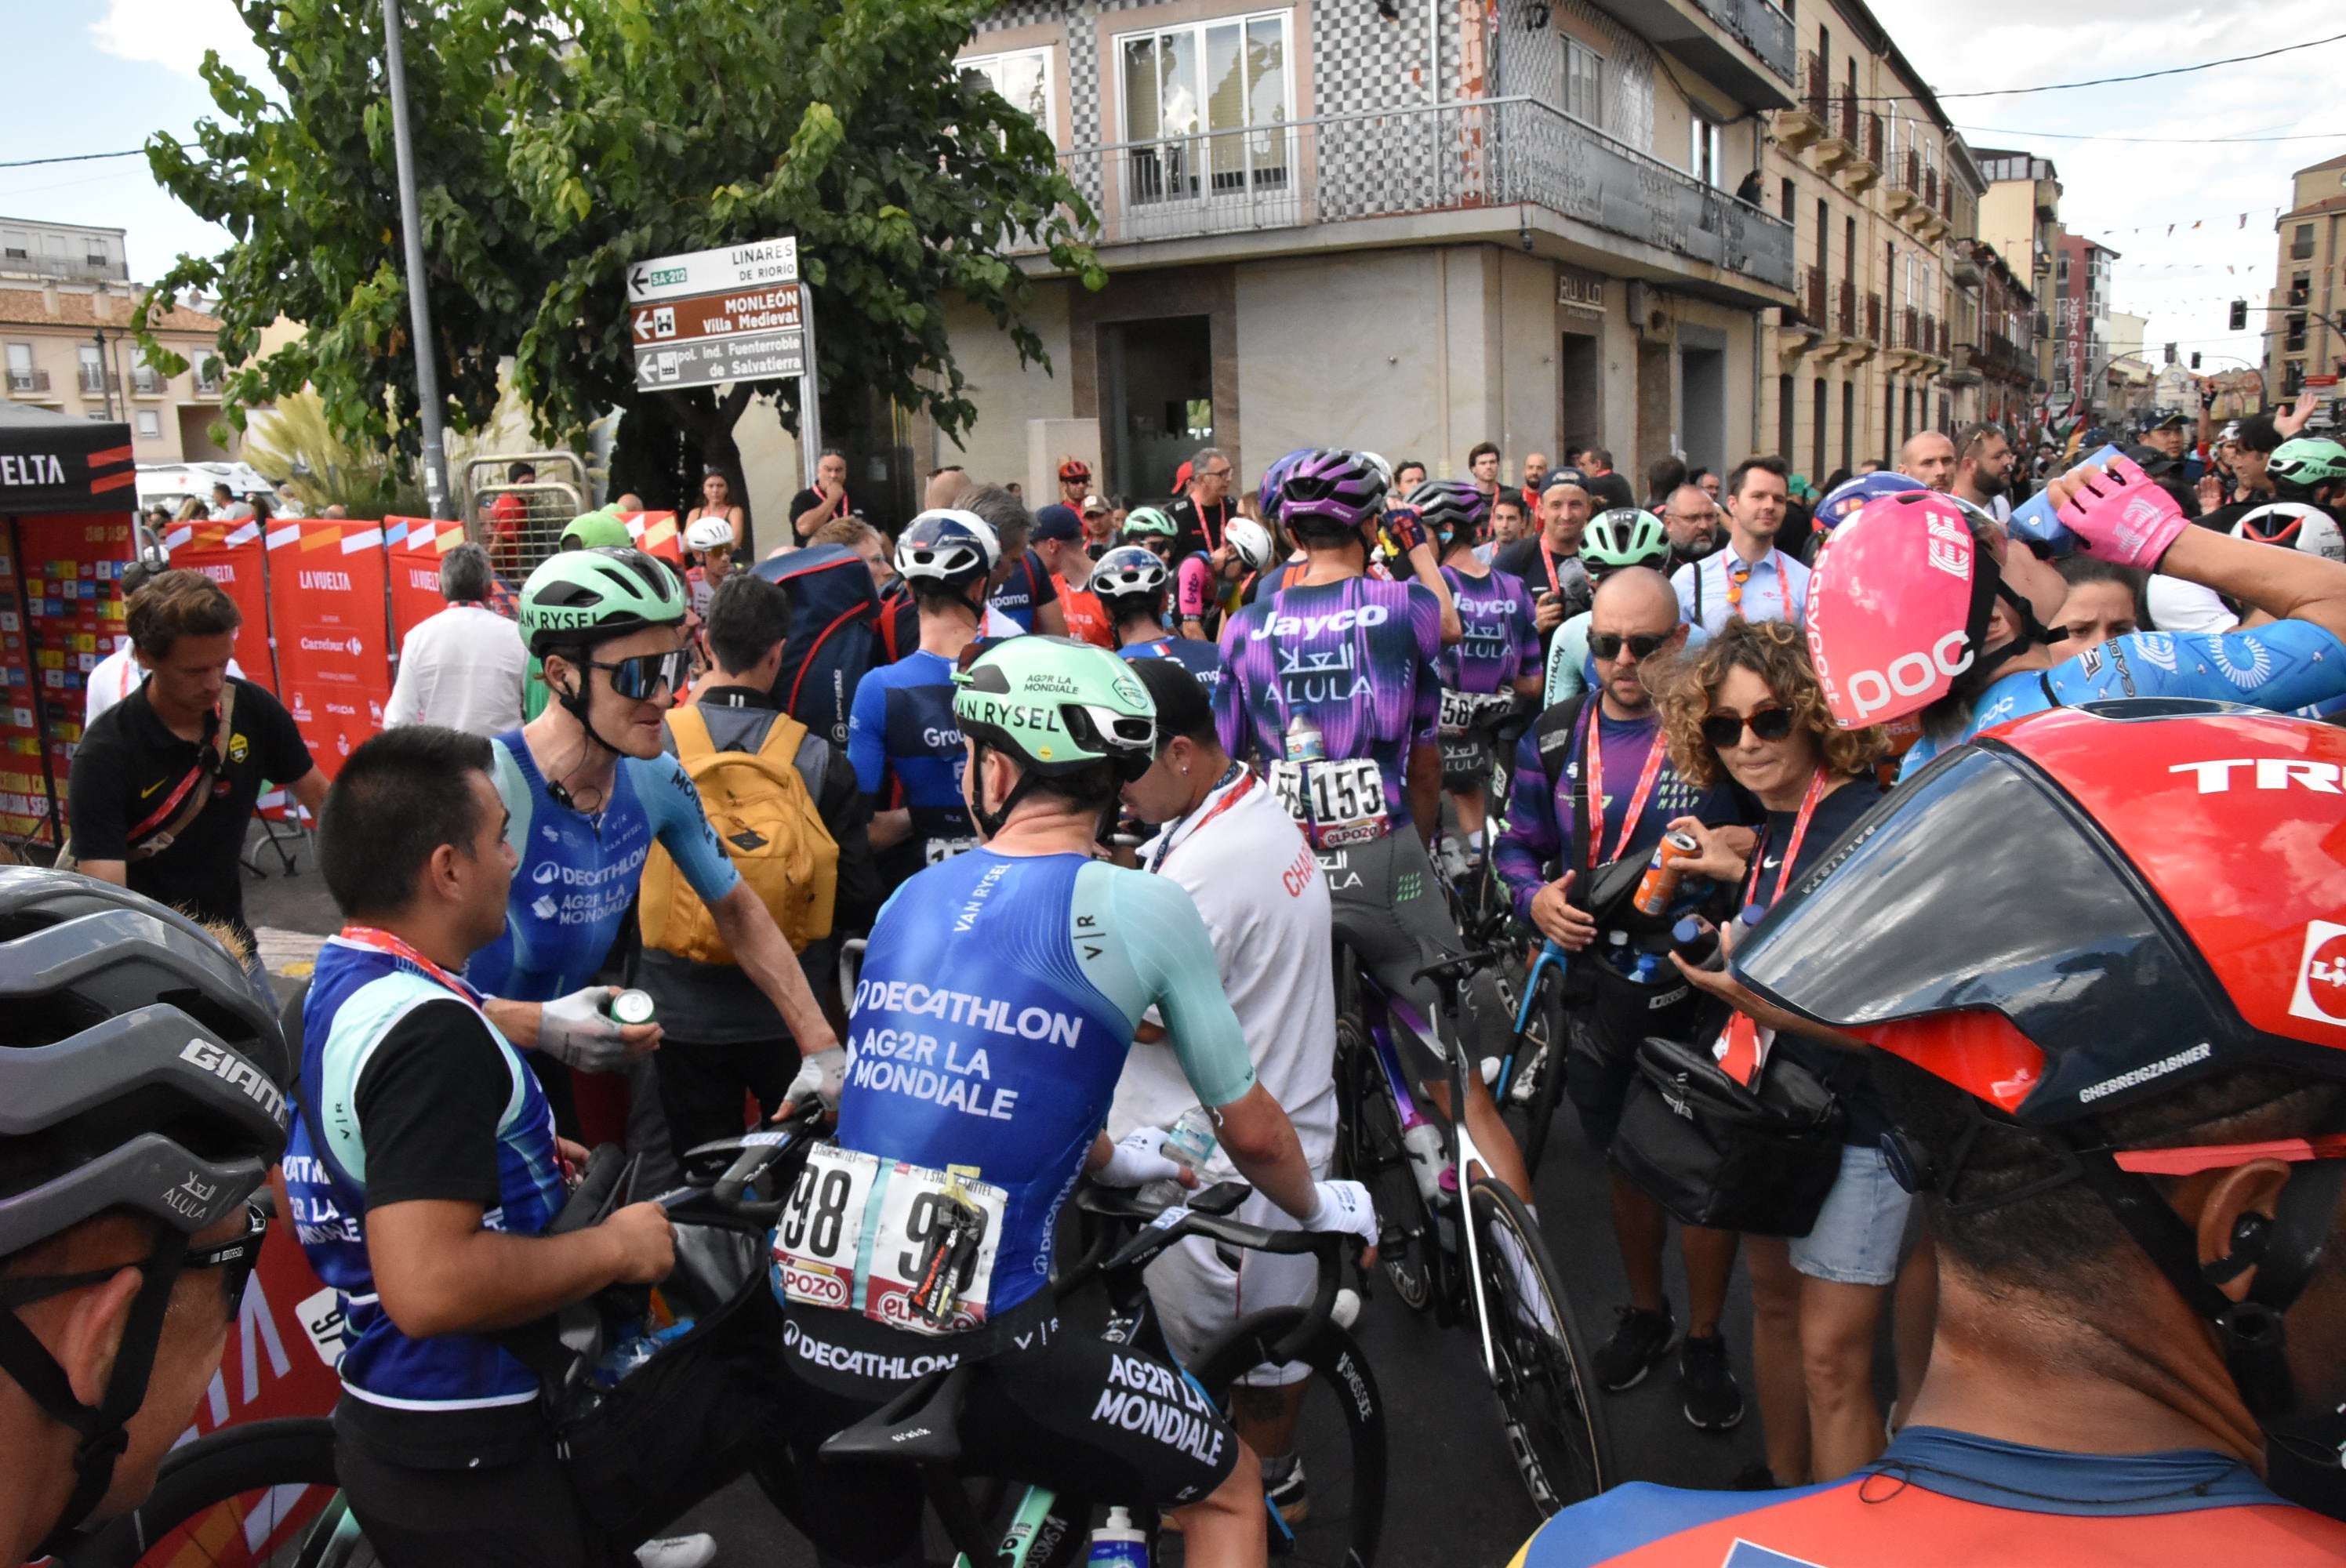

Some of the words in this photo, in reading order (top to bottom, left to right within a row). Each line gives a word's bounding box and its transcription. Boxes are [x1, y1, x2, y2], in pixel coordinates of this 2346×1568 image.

[732, 244, 794, 265] LINARES
[652, 269, 686, 285] SA-212
[739, 270, 753, 281] DE
[725, 289, 798, 314] MONLEÓN
[703, 318, 732, 333] Villa
[739, 310, 799, 329] Medieval
[703, 346, 723, 360] ind.
[728, 337, 800, 357] Fuenterroble
[709, 364, 724, 378] de
[732, 355, 801, 375] Salvatierra
[0, 454, 66, 485] ELTA
[312, 572, 351, 591] VUELTA
[540, 609, 600, 630] RYSEL
[1454, 591, 1517, 617] Jayco
[1251, 604, 1389, 641] Jayco
[1806, 549, 1840, 706] easypost
[1024, 683, 1080, 695] MONDIALE
[1058, 676, 1072, 684] LA
[1263, 675, 1375, 706] ALULA
[984, 702, 1061, 733] RYSEL
[2170, 758, 2346, 795] TR
[1312, 766, 1381, 822] 155
[561, 844, 648, 887] DECATHLON
[606, 884, 625, 901] LA
[953, 901, 983, 932] VAN
[971, 862, 1012, 898] RYSEL
[867, 980, 1083, 1049] DECATHLON
[861, 1028, 939, 1066] AG2R
[945, 1043, 991, 1080] LA
[179, 1037, 289, 1131] GIANT
[2078, 1041, 2213, 1104] GHEBREIGZABHIER
[852, 1058, 1019, 1121] MONDIALE
[161, 1188, 207, 1221] ALULA
[310, 1197, 340, 1222] LA
[783, 1161, 852, 1258] 98
[927, 1290, 939, 1313] FUEL
[799, 1334, 960, 1380] DECATHLON
[1107, 1354, 1178, 1403] AG2R
[1177, 1375, 1211, 1419] LA
[1091, 1388, 1225, 1467] MONDIALE
